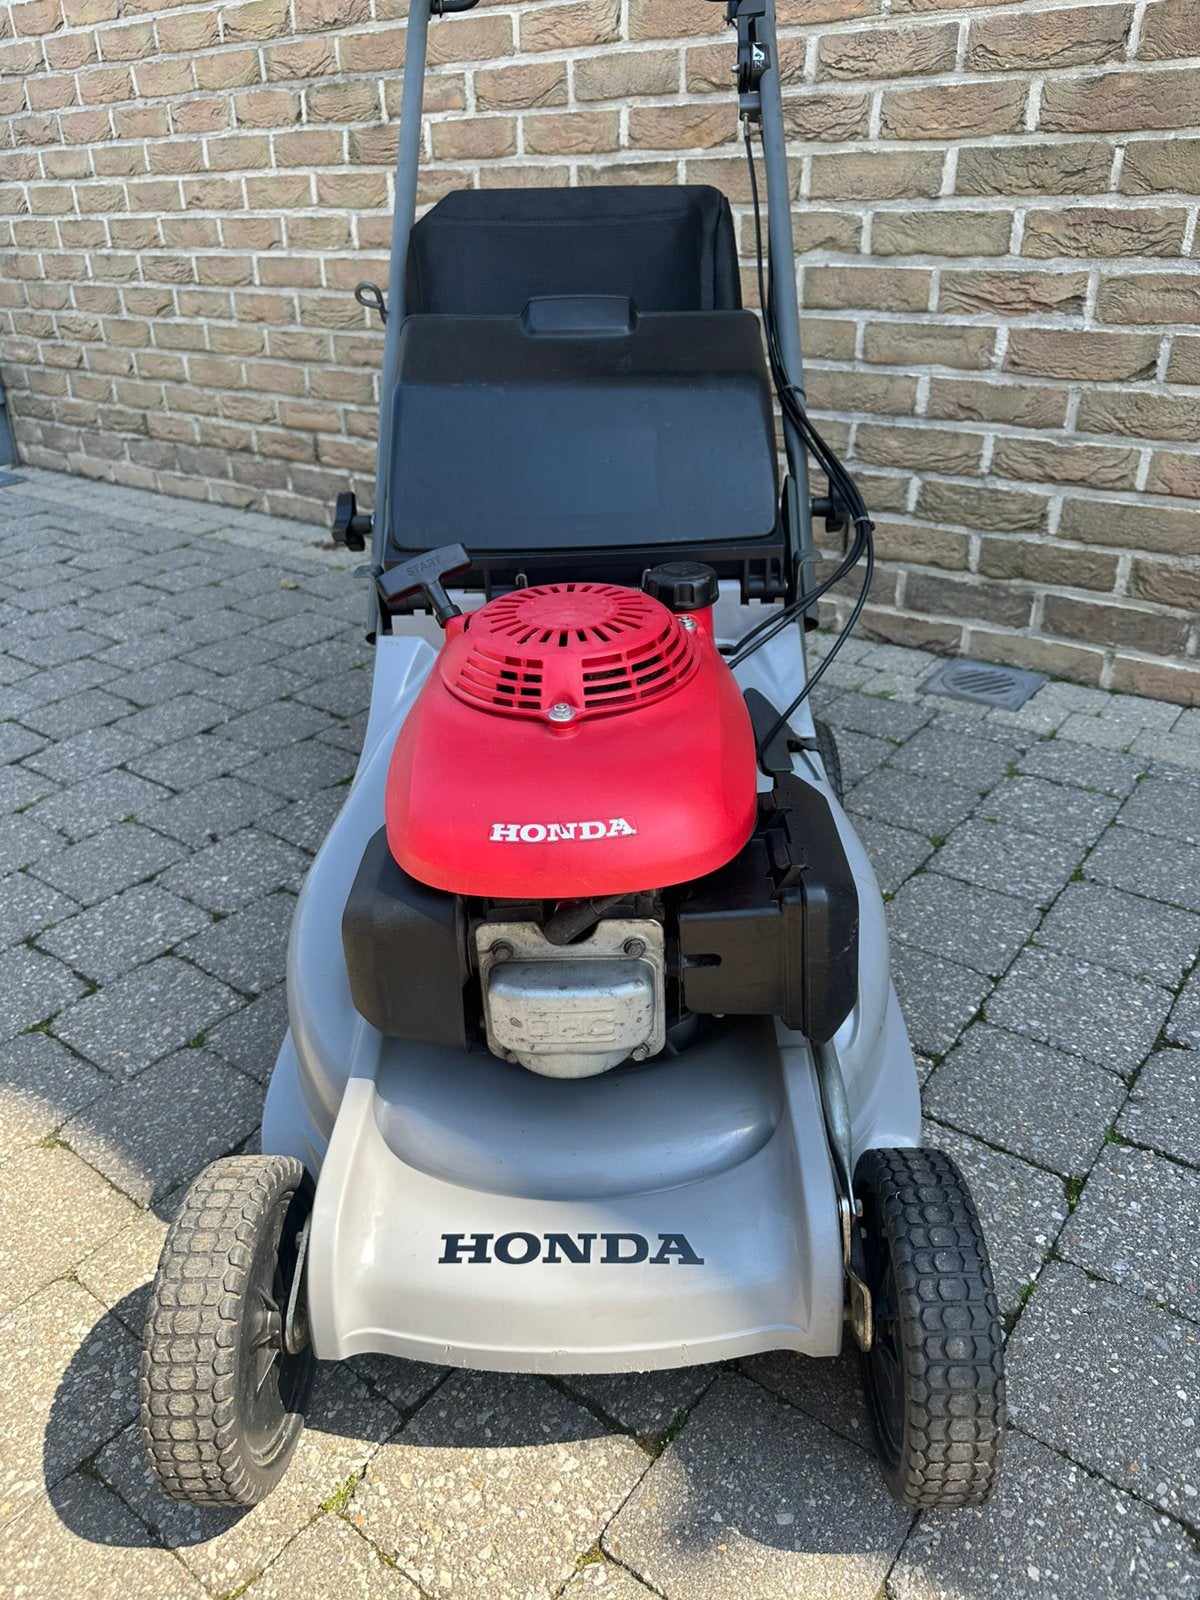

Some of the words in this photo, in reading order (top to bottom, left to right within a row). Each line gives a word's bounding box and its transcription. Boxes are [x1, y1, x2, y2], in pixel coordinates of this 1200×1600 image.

[406, 555, 441, 577] START
[489, 817, 637, 843] HONDA
[438, 1231, 705, 1265] HONDA
